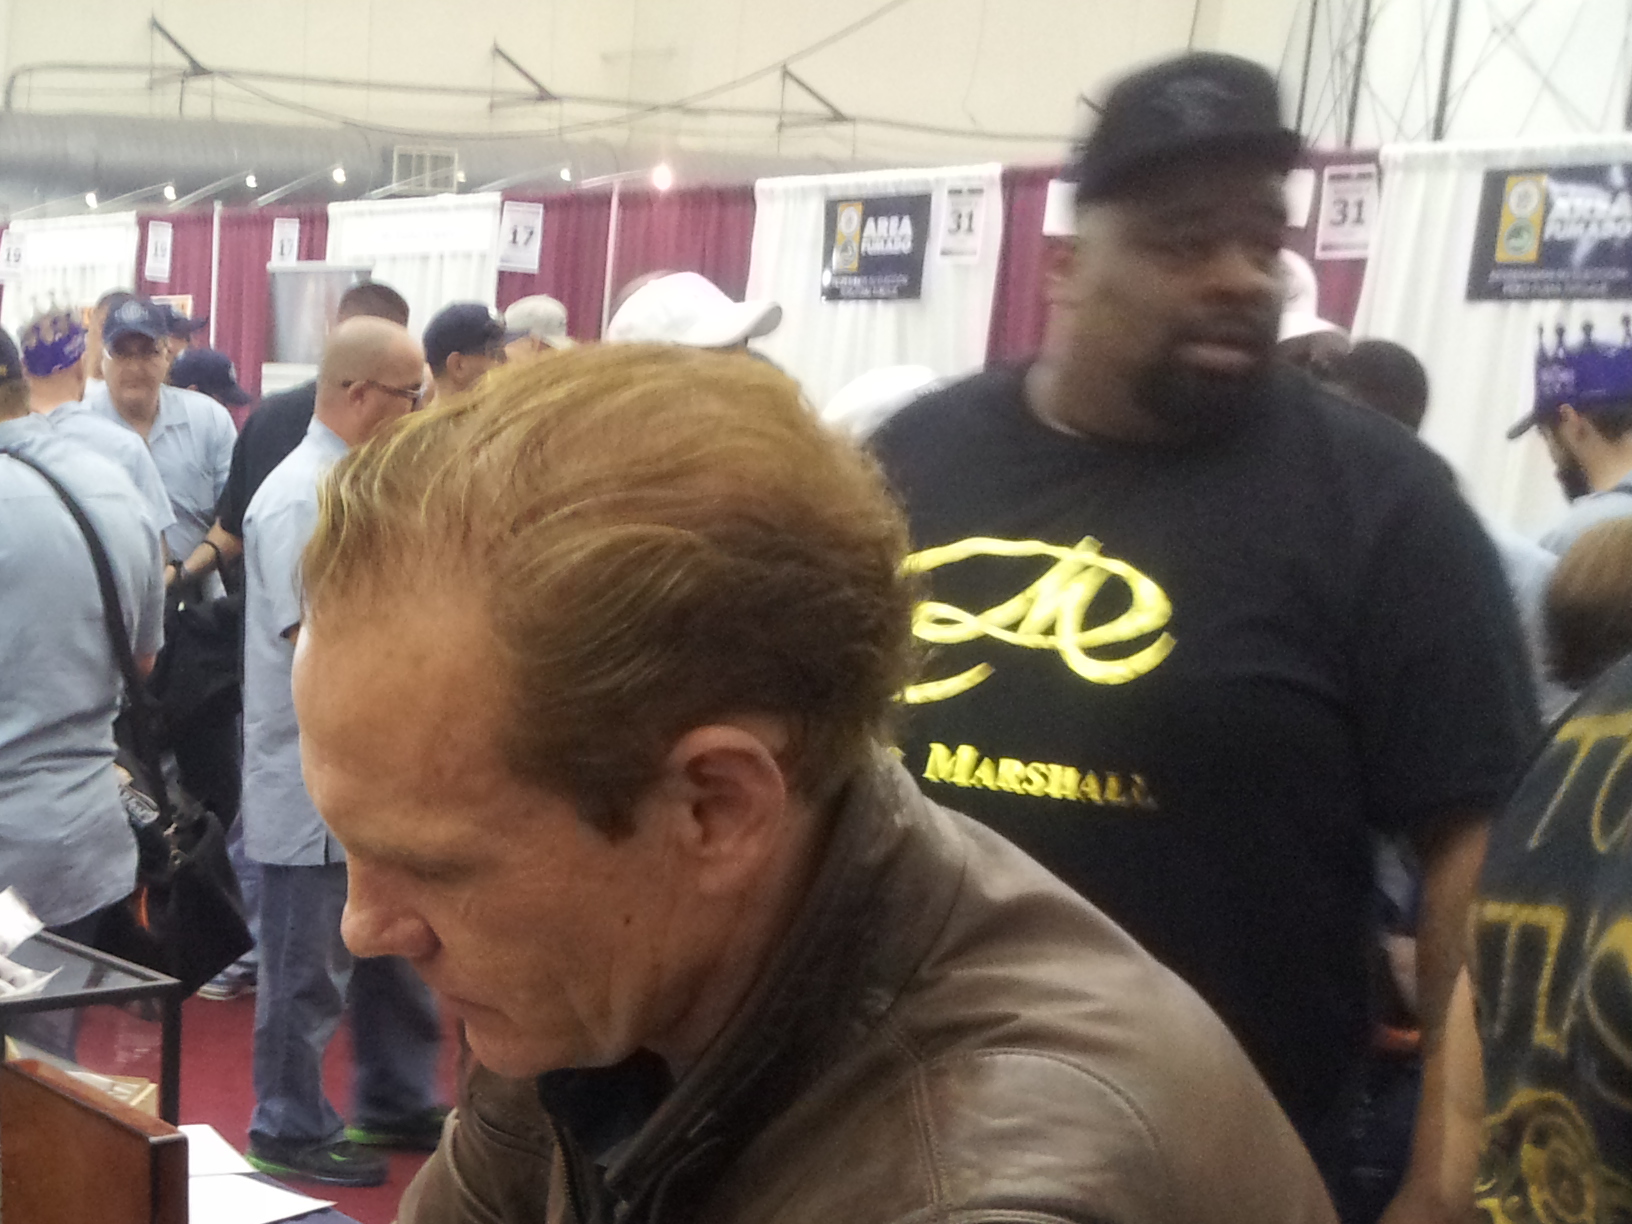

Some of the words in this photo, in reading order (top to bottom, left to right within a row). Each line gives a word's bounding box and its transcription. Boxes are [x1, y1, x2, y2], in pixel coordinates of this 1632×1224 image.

[948, 211, 974, 234] 31
[1330, 200, 1367, 225] 31
[508, 226, 534, 246] 17
